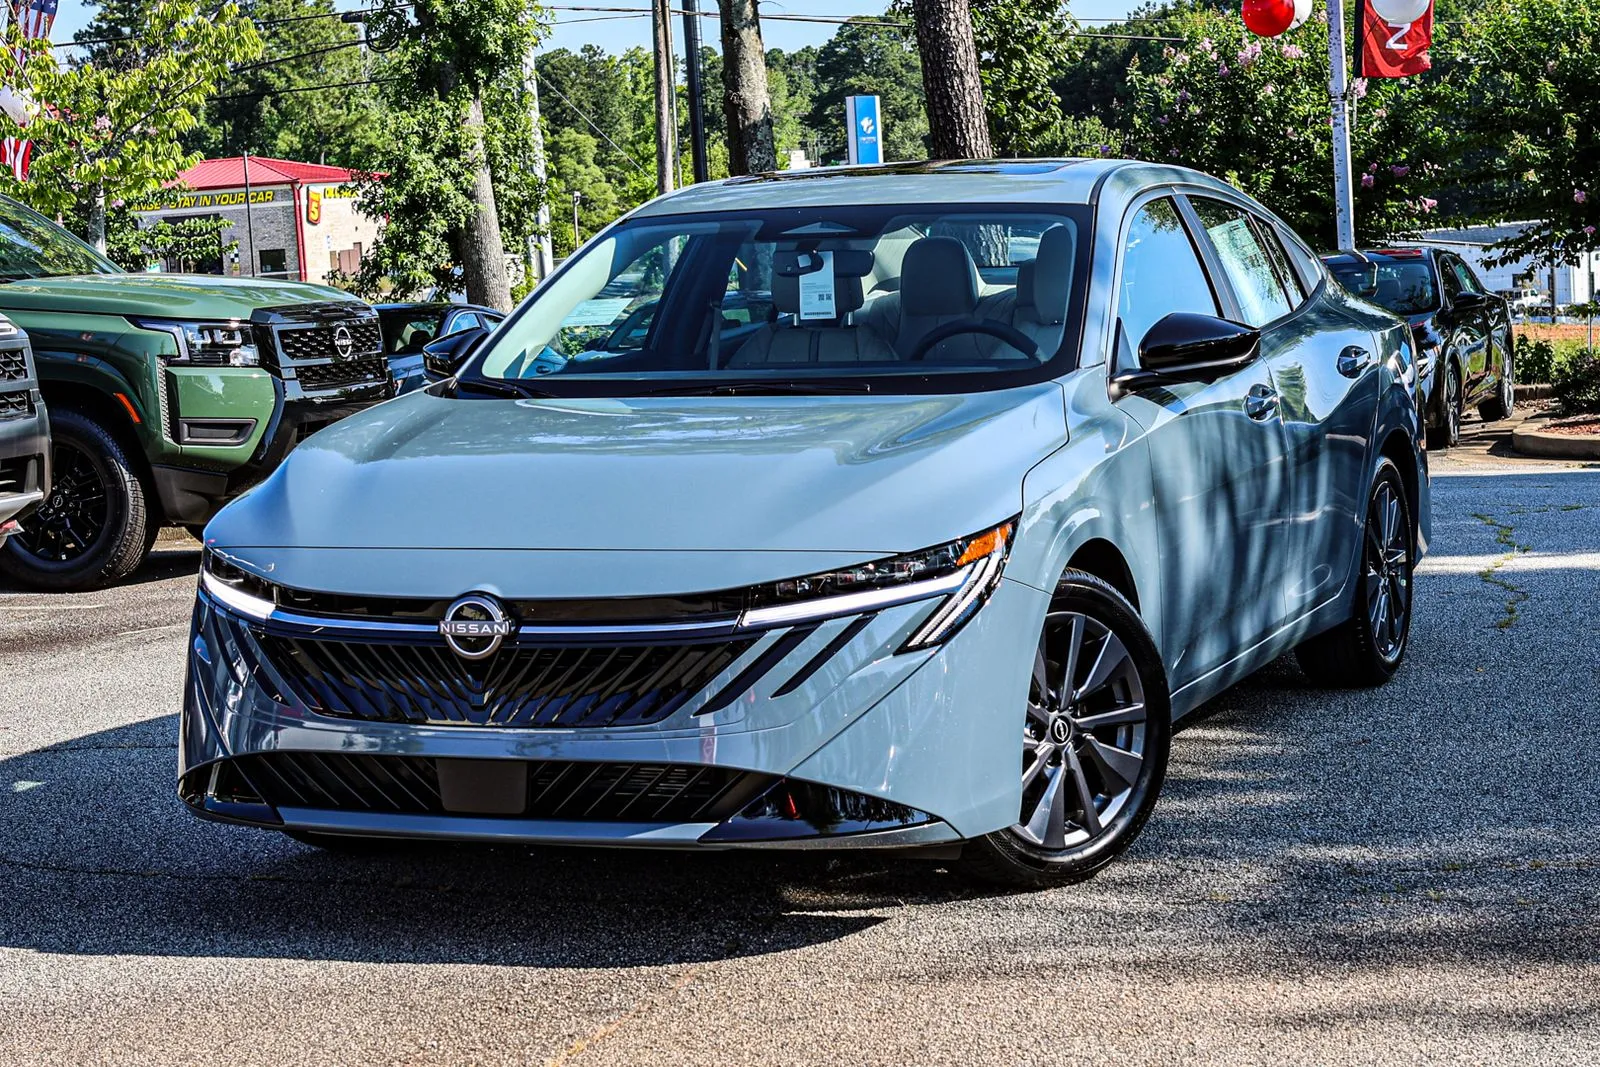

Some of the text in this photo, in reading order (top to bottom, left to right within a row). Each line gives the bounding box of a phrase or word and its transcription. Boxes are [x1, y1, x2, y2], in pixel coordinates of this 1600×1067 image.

[199, 195, 212, 207] IN
[214, 192, 246, 206] YOUR
[249, 190, 274, 204] CAR
[310, 201, 319, 221] 5
[440, 623, 506, 633] NISSAN
